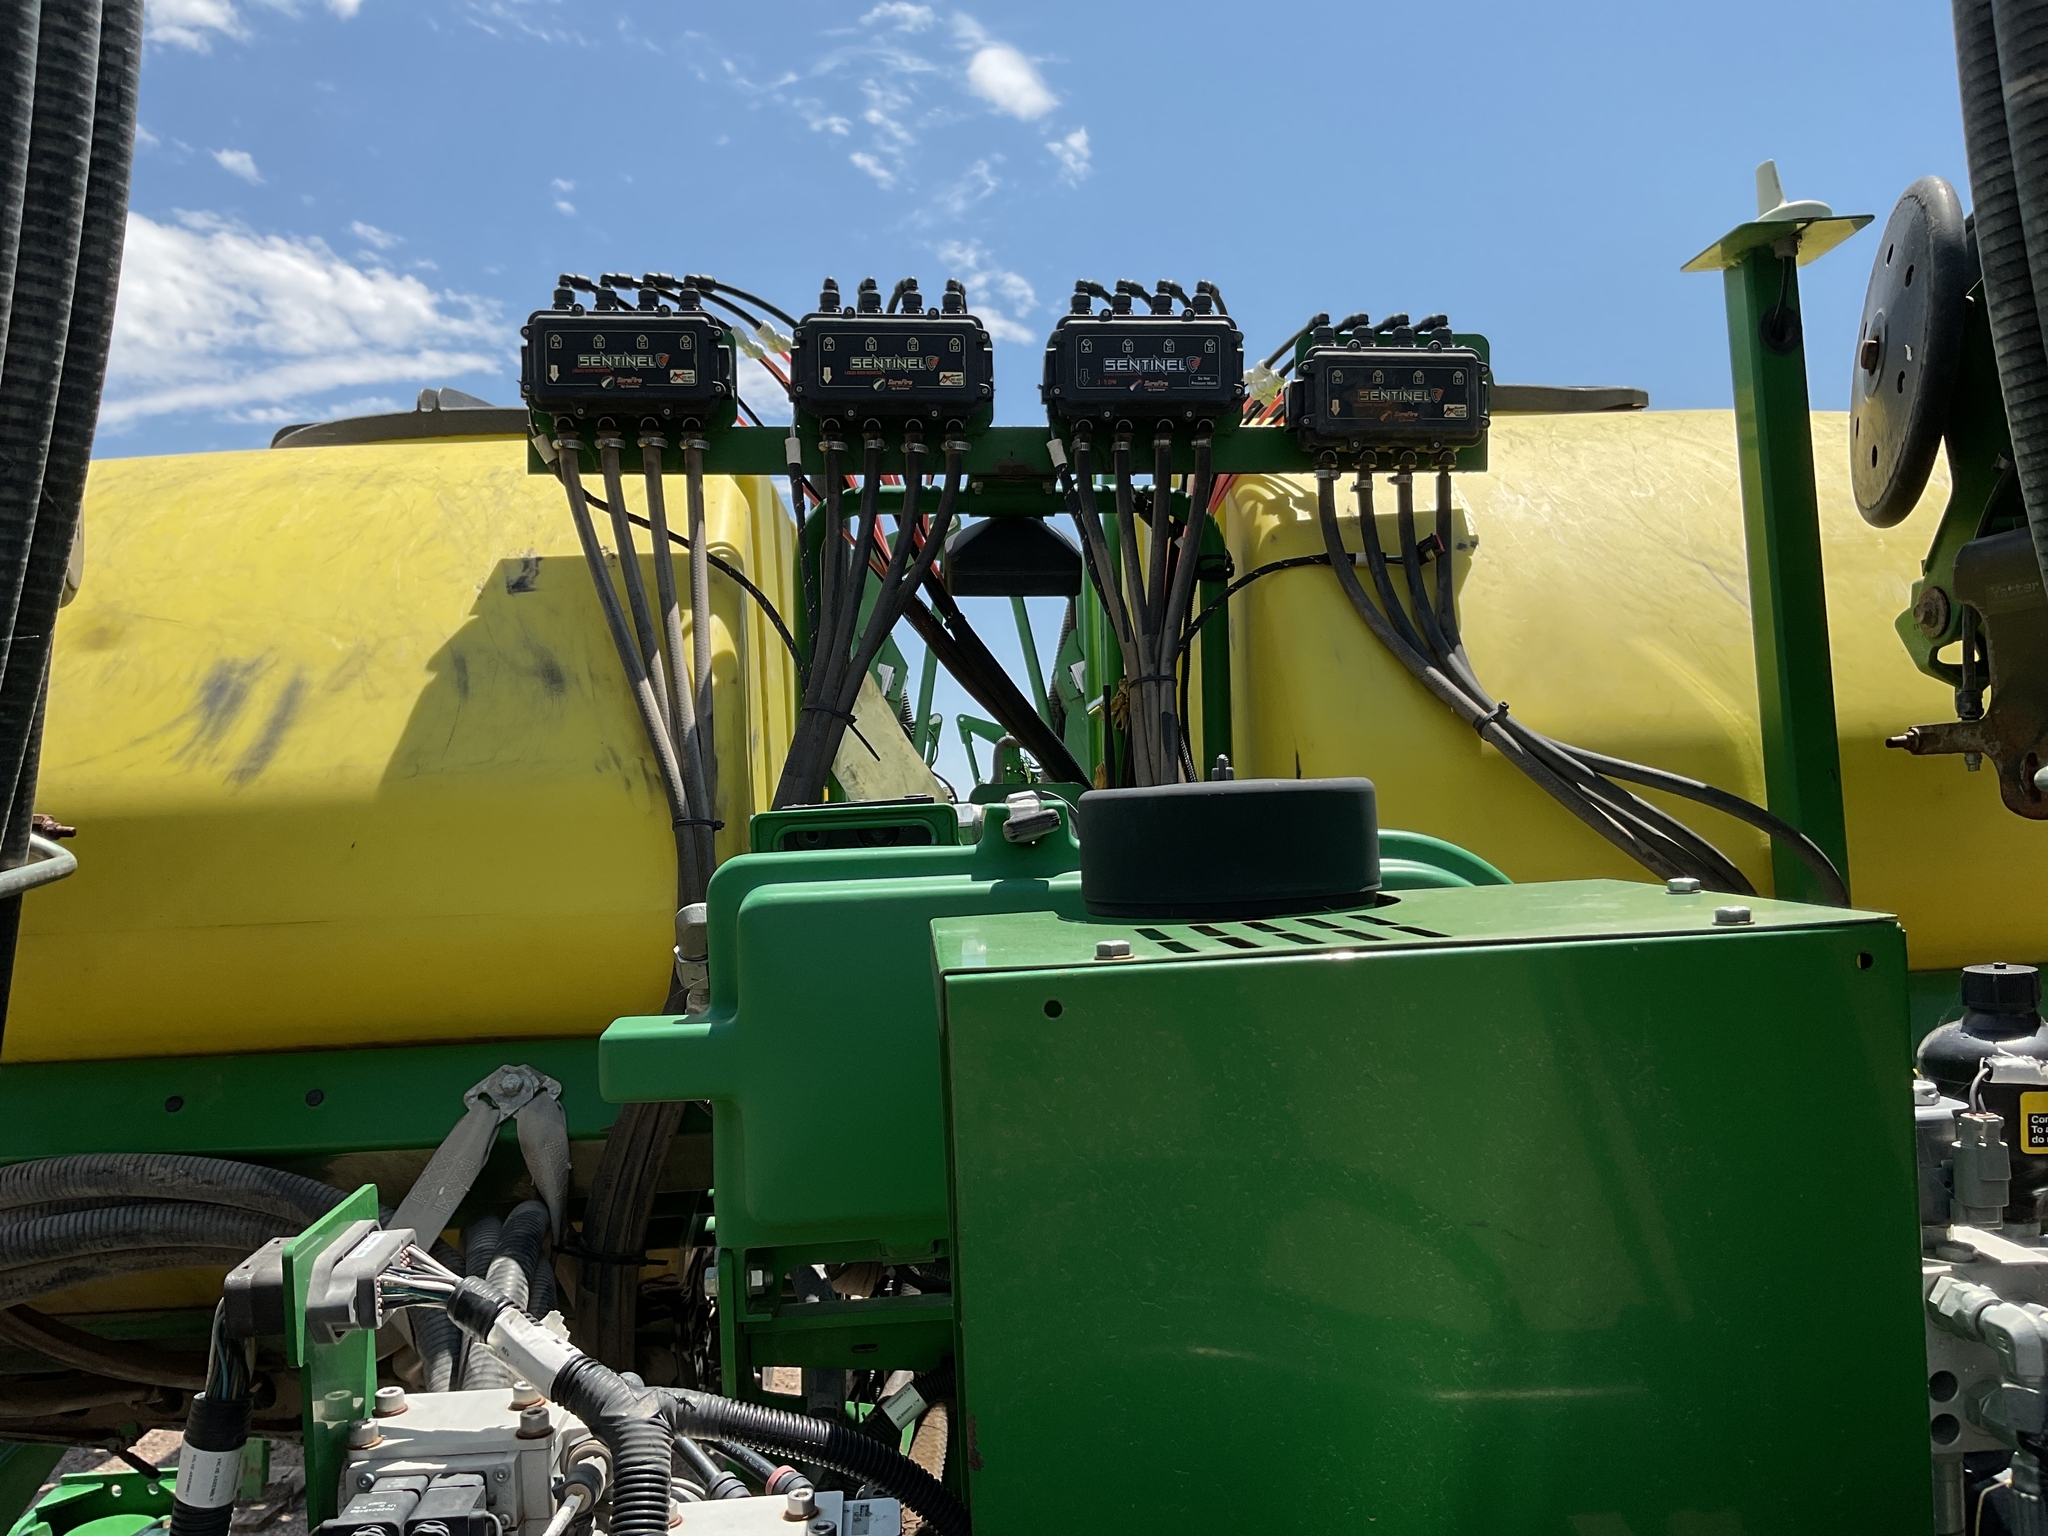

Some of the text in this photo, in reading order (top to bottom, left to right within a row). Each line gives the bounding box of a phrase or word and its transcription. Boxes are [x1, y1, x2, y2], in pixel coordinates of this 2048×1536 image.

[578, 352, 656, 371] SENTINEL
[850, 354, 926, 372] SENTINEL
[1104, 355, 1186, 375] SENTINEL
[1358, 387, 1432, 405] SENTINEL
[2031, 1125, 2043, 1133] To
[209, 1458, 222, 1501] VALVE ASSEMBLY
